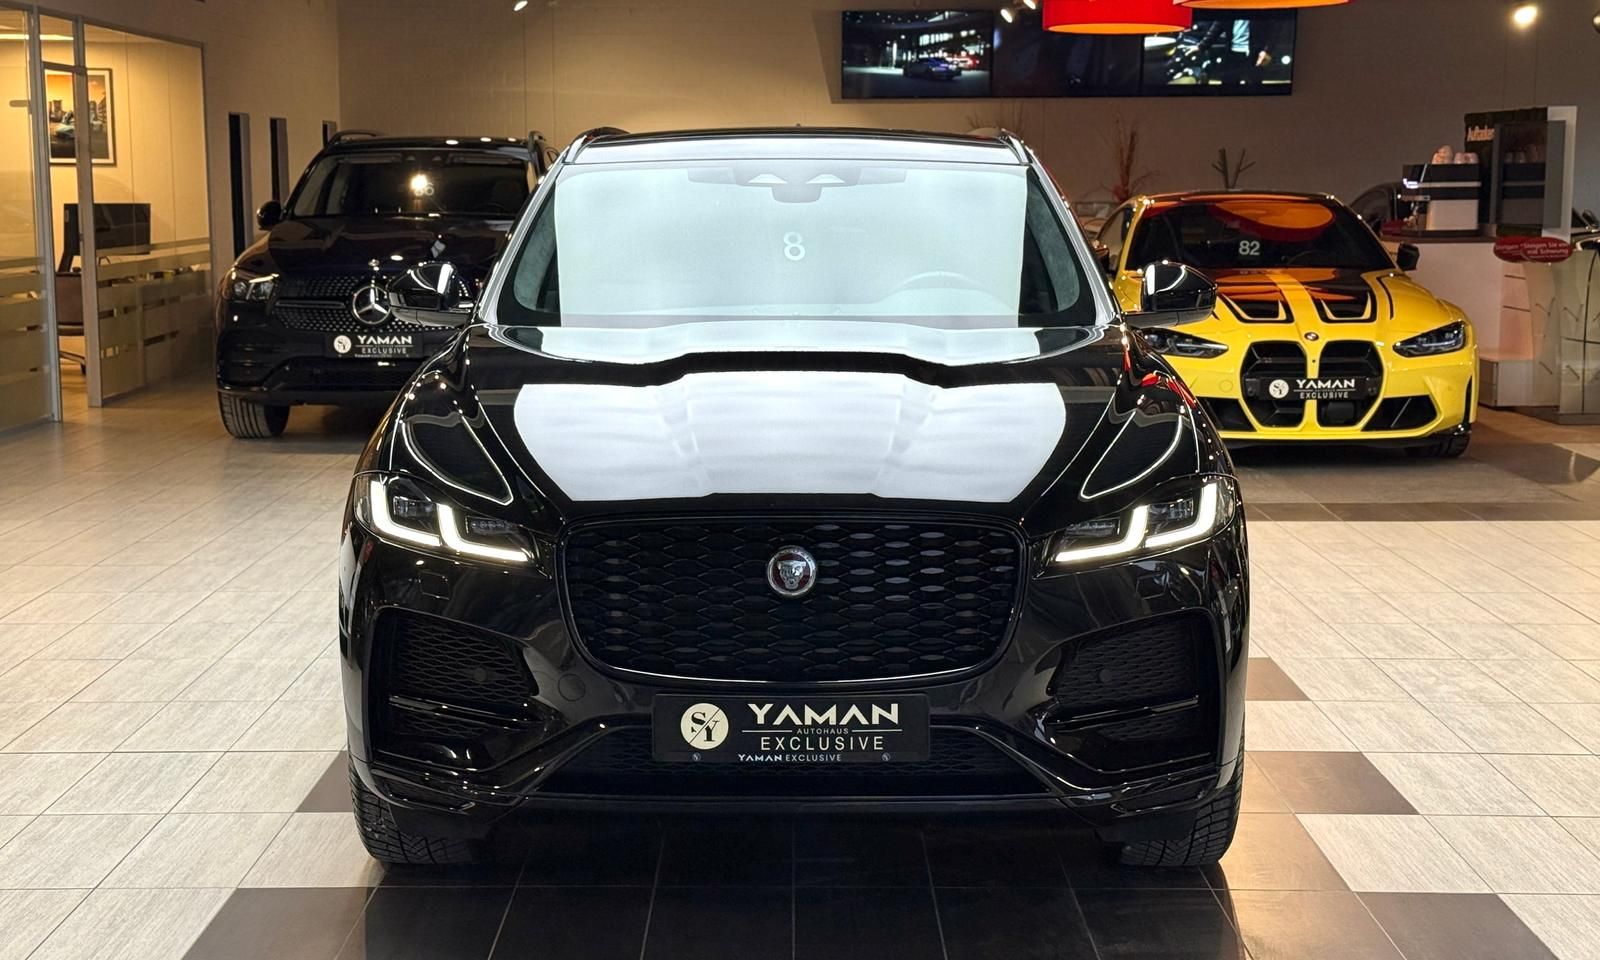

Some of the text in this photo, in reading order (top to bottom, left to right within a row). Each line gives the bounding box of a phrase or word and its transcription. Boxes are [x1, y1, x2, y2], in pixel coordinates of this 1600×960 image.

[783, 231, 806, 261] 8
[1238, 240, 1260, 256] 82
[357, 335, 412, 345] YAMAN
[1296, 378, 1355, 389] YAMAN
[1300, 391, 1349, 399] EXCLUSIVE
[747, 703, 899, 726] YAMAN
[760, 736, 884, 750] EXCLUSIVE
[738, 754, 842, 762] YAMAN EXCLUSIVE
